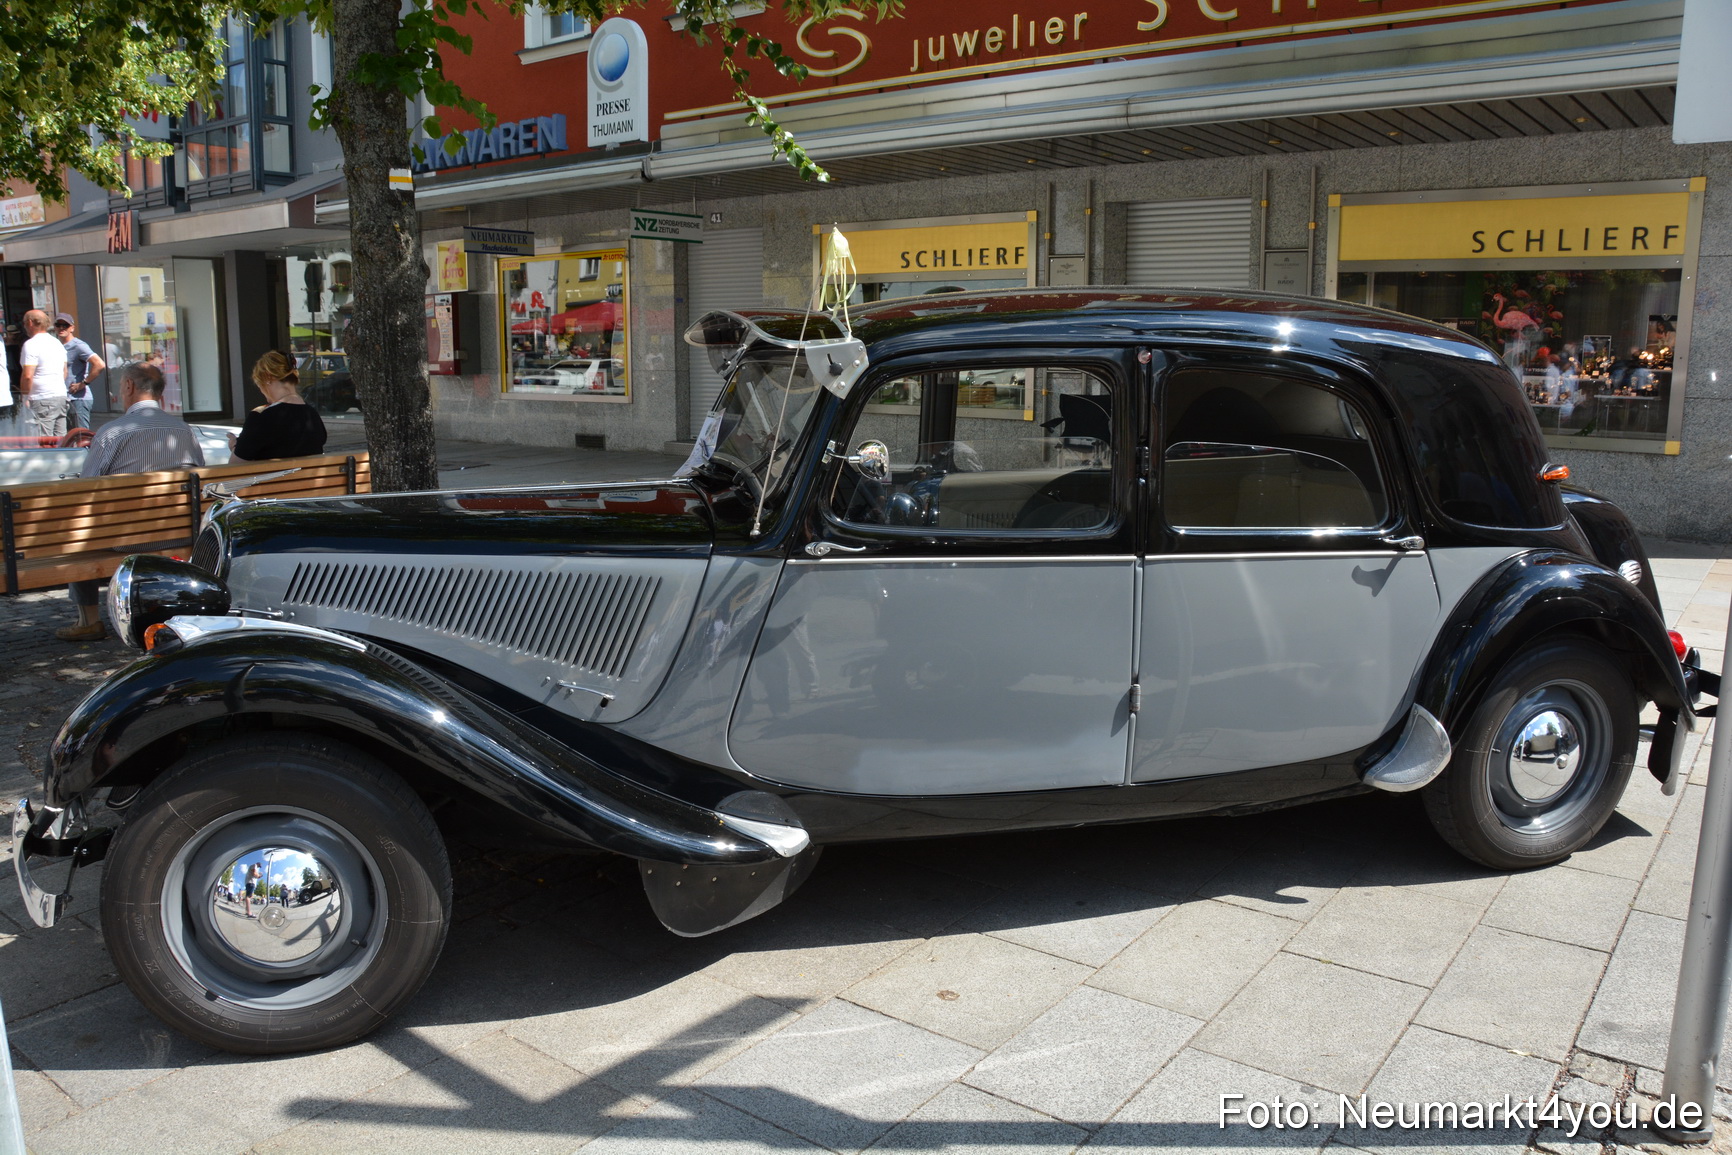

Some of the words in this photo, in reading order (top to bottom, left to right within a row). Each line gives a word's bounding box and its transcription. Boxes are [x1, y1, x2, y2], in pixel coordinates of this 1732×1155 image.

[910, 12, 1087, 72] juwelier
[596, 98, 631, 117] PRESSE
[593, 119, 633, 137] THUMANN
[411, 113, 567, 172] AKWAREN
[634, 217, 658, 232] NZ
[659, 219, 700, 229] NORDBAYERISCHE
[711, 213, 721, 223] 41
[470, 230, 528, 245] NEUMARKTER
[659, 226, 680, 234] ZEITUNG
[1472, 225, 1679, 253] SCHLIERF
[481, 243, 518, 253] Nachrichten
[900, 246, 1025, 269] SCHLIERF
[442, 267, 464, 279] LOTTO
